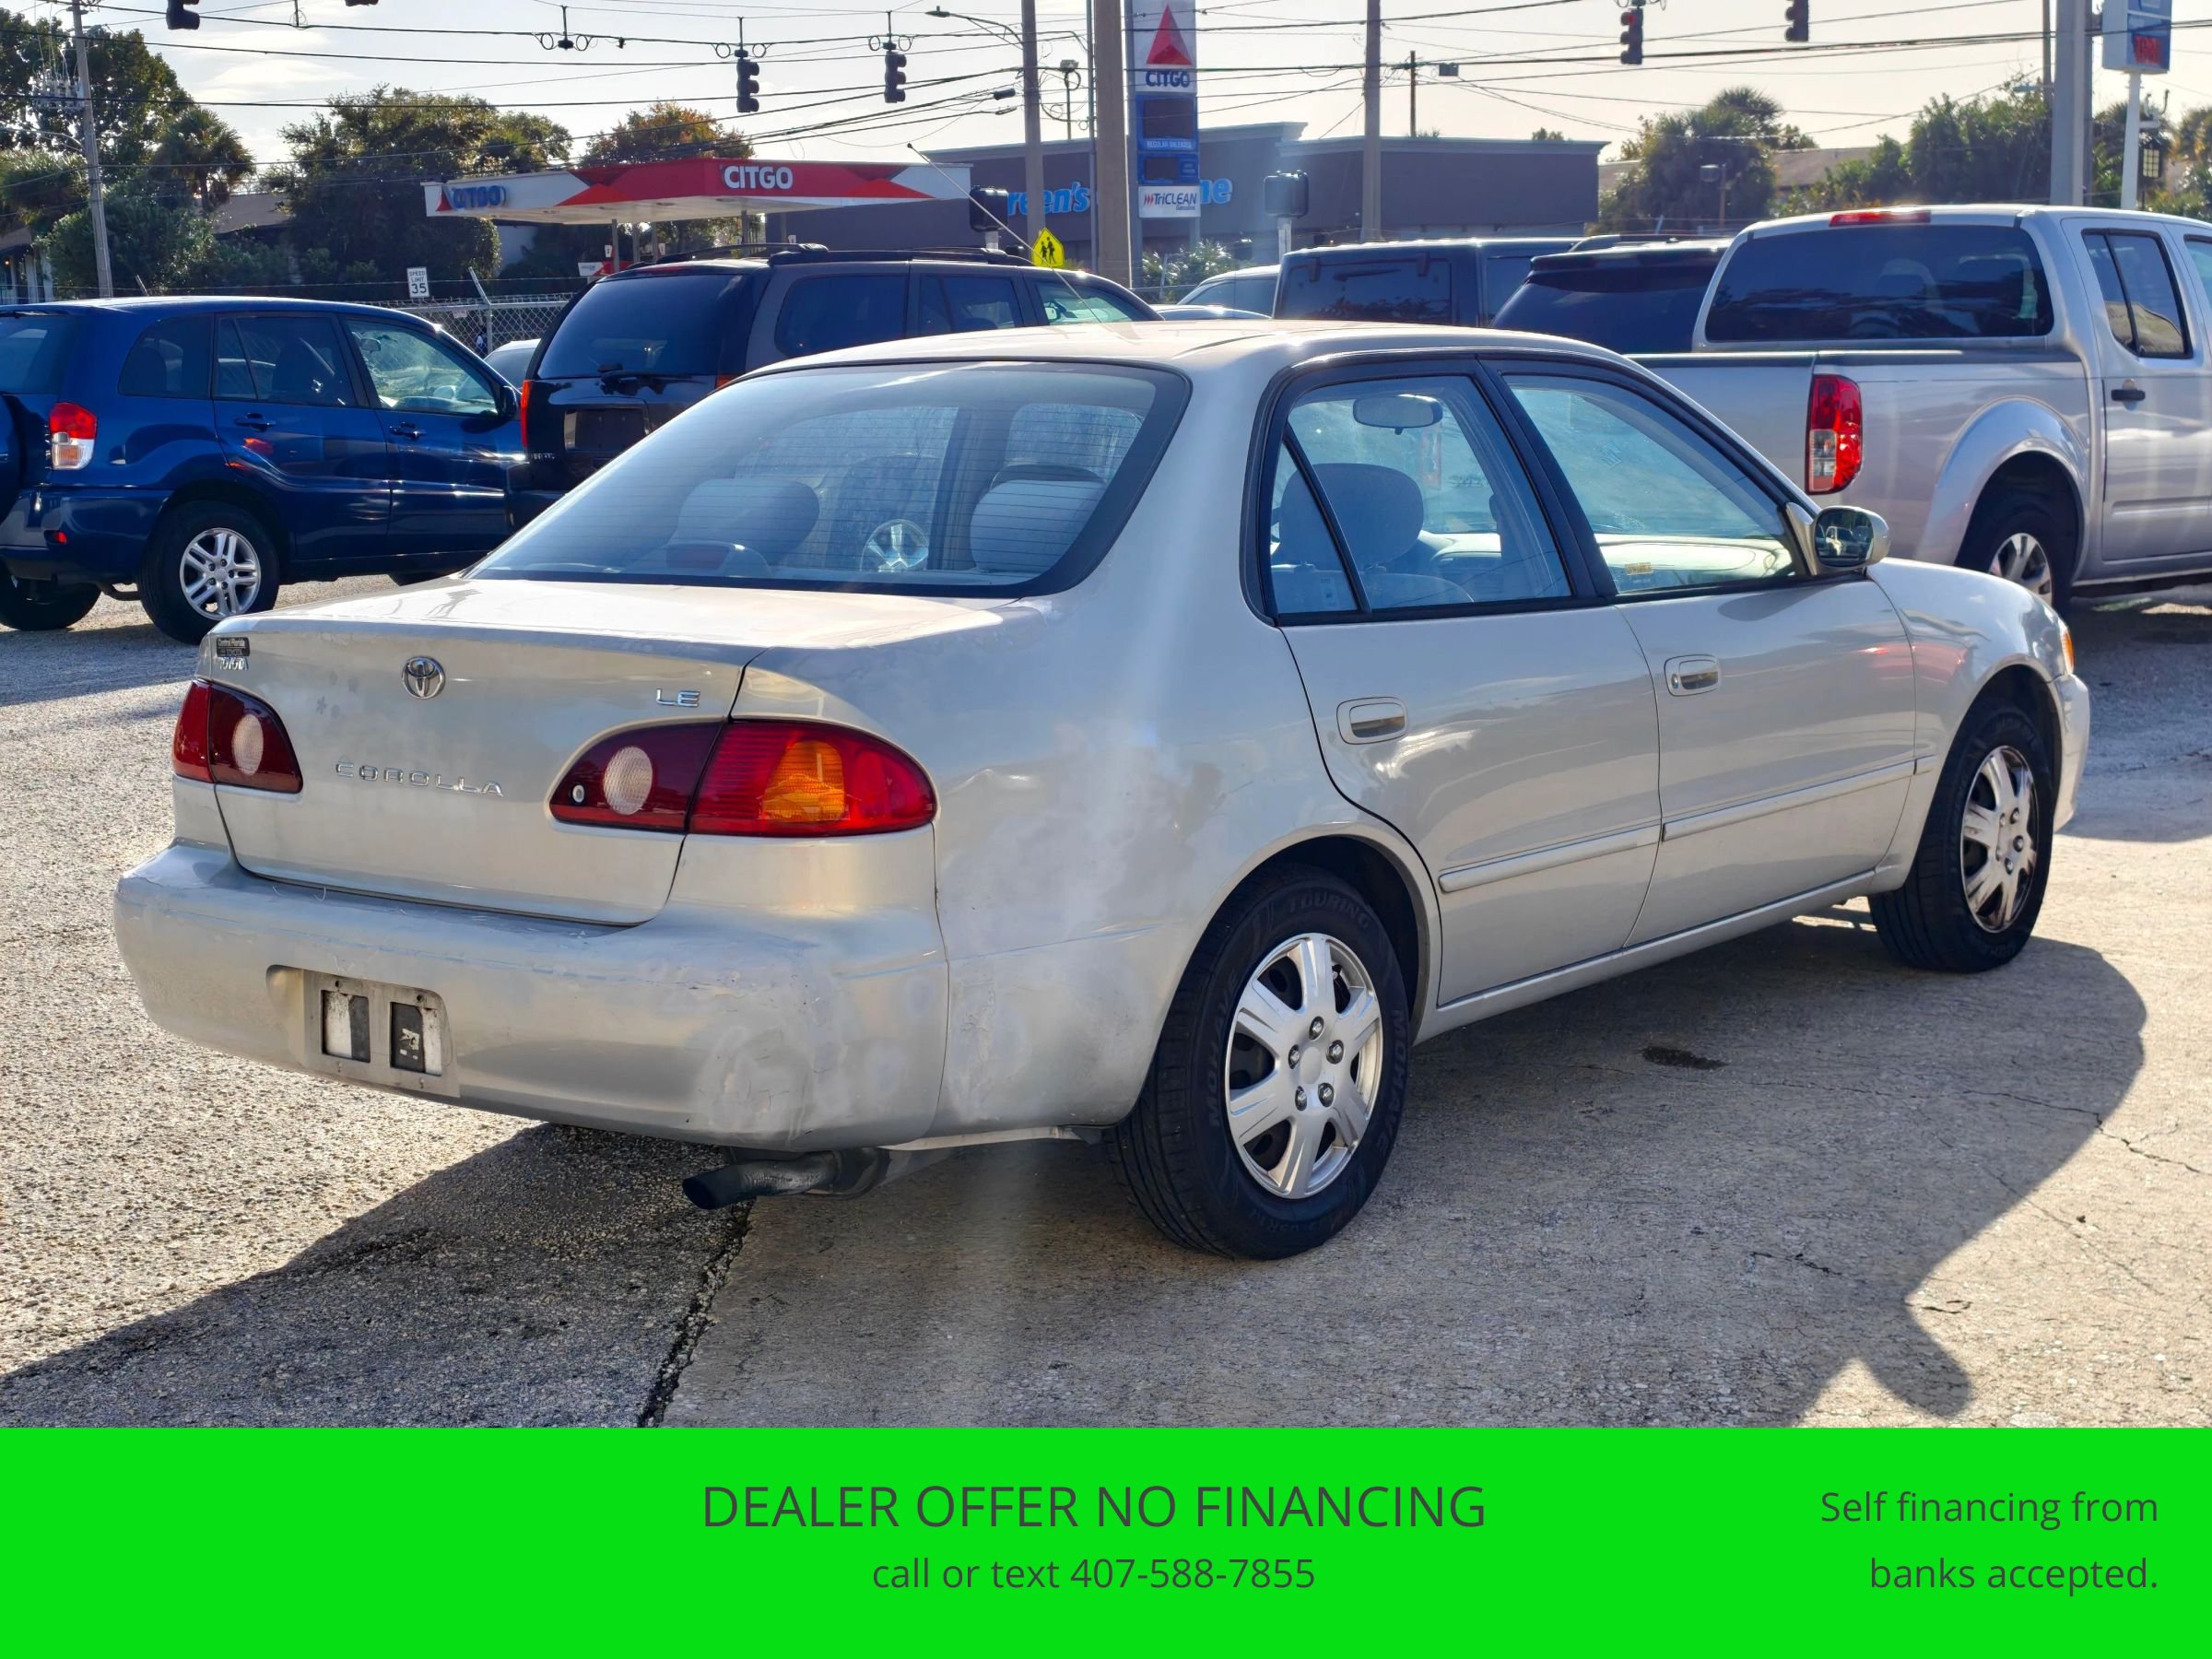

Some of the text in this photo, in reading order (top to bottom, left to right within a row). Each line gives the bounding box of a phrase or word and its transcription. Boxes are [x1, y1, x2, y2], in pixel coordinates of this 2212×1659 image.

[1146, 70, 1190, 88] CITGO
[724, 166, 793, 189] CITGO
[1154, 193, 1197, 205] TriCLEAN
[411, 283, 427, 293] 35
[656, 688, 701, 707] LE
[335, 761, 503, 797] COROLLA
